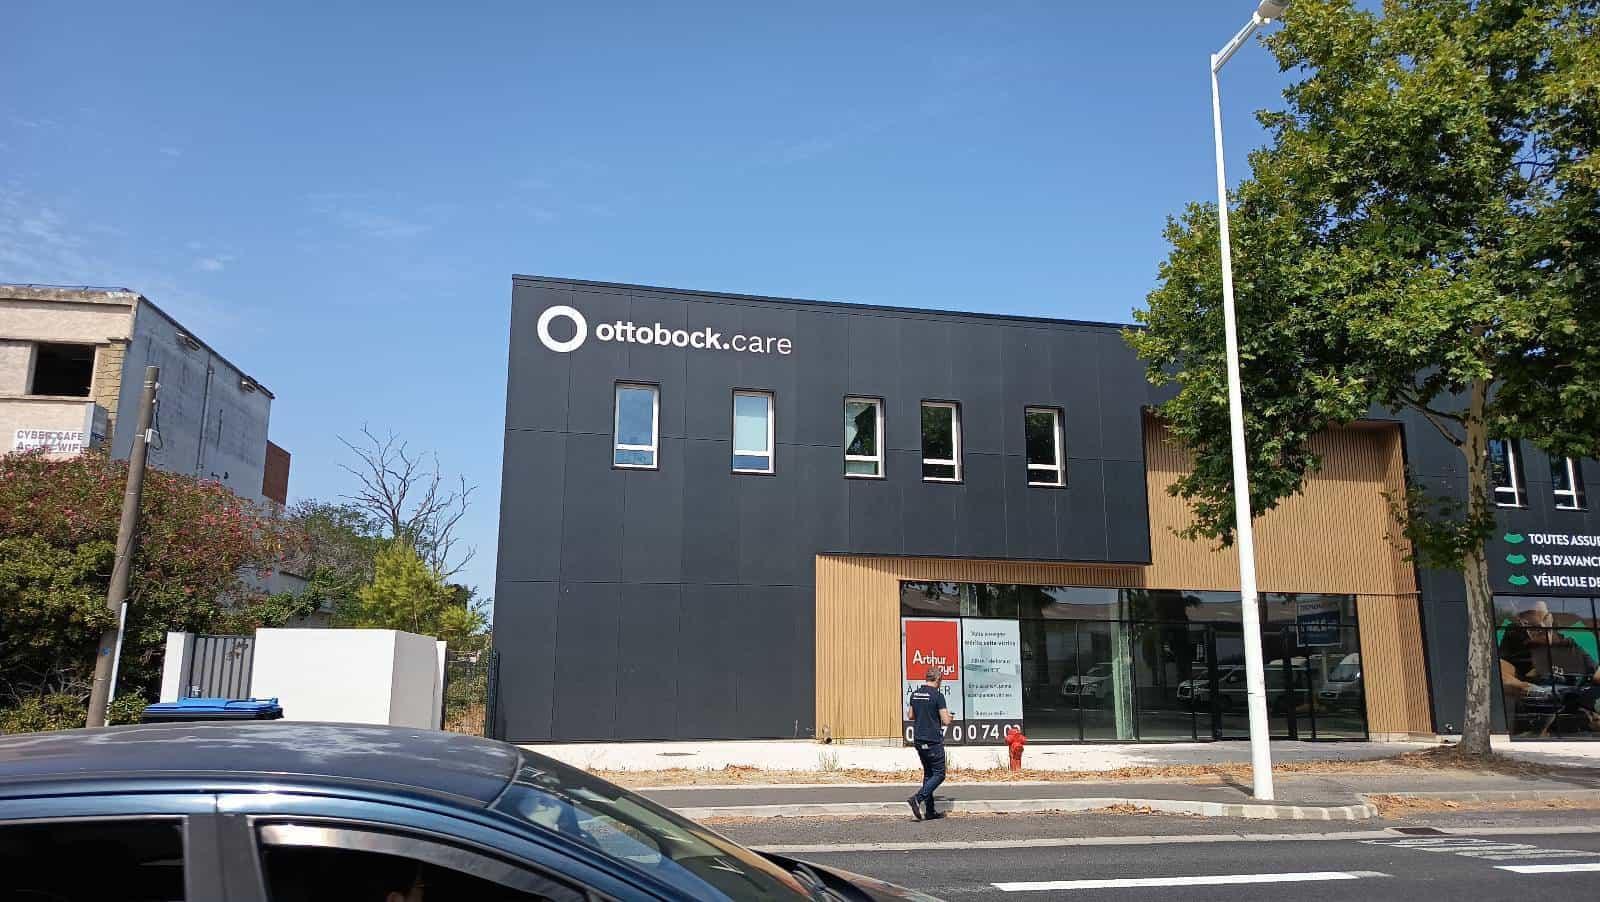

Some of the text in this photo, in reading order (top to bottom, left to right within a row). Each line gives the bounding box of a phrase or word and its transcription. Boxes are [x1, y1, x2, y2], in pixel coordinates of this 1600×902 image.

[596, 321, 792, 355] ottobock.care
[16, 430, 51, 440] CYBER
[1528, 533, 1569, 546] TOUTES
[1532, 554, 1600, 567] PAS D'AVANC
[1533, 572, 1587, 587] VÉHICULE
[912, 649, 946, 665] Arthur
